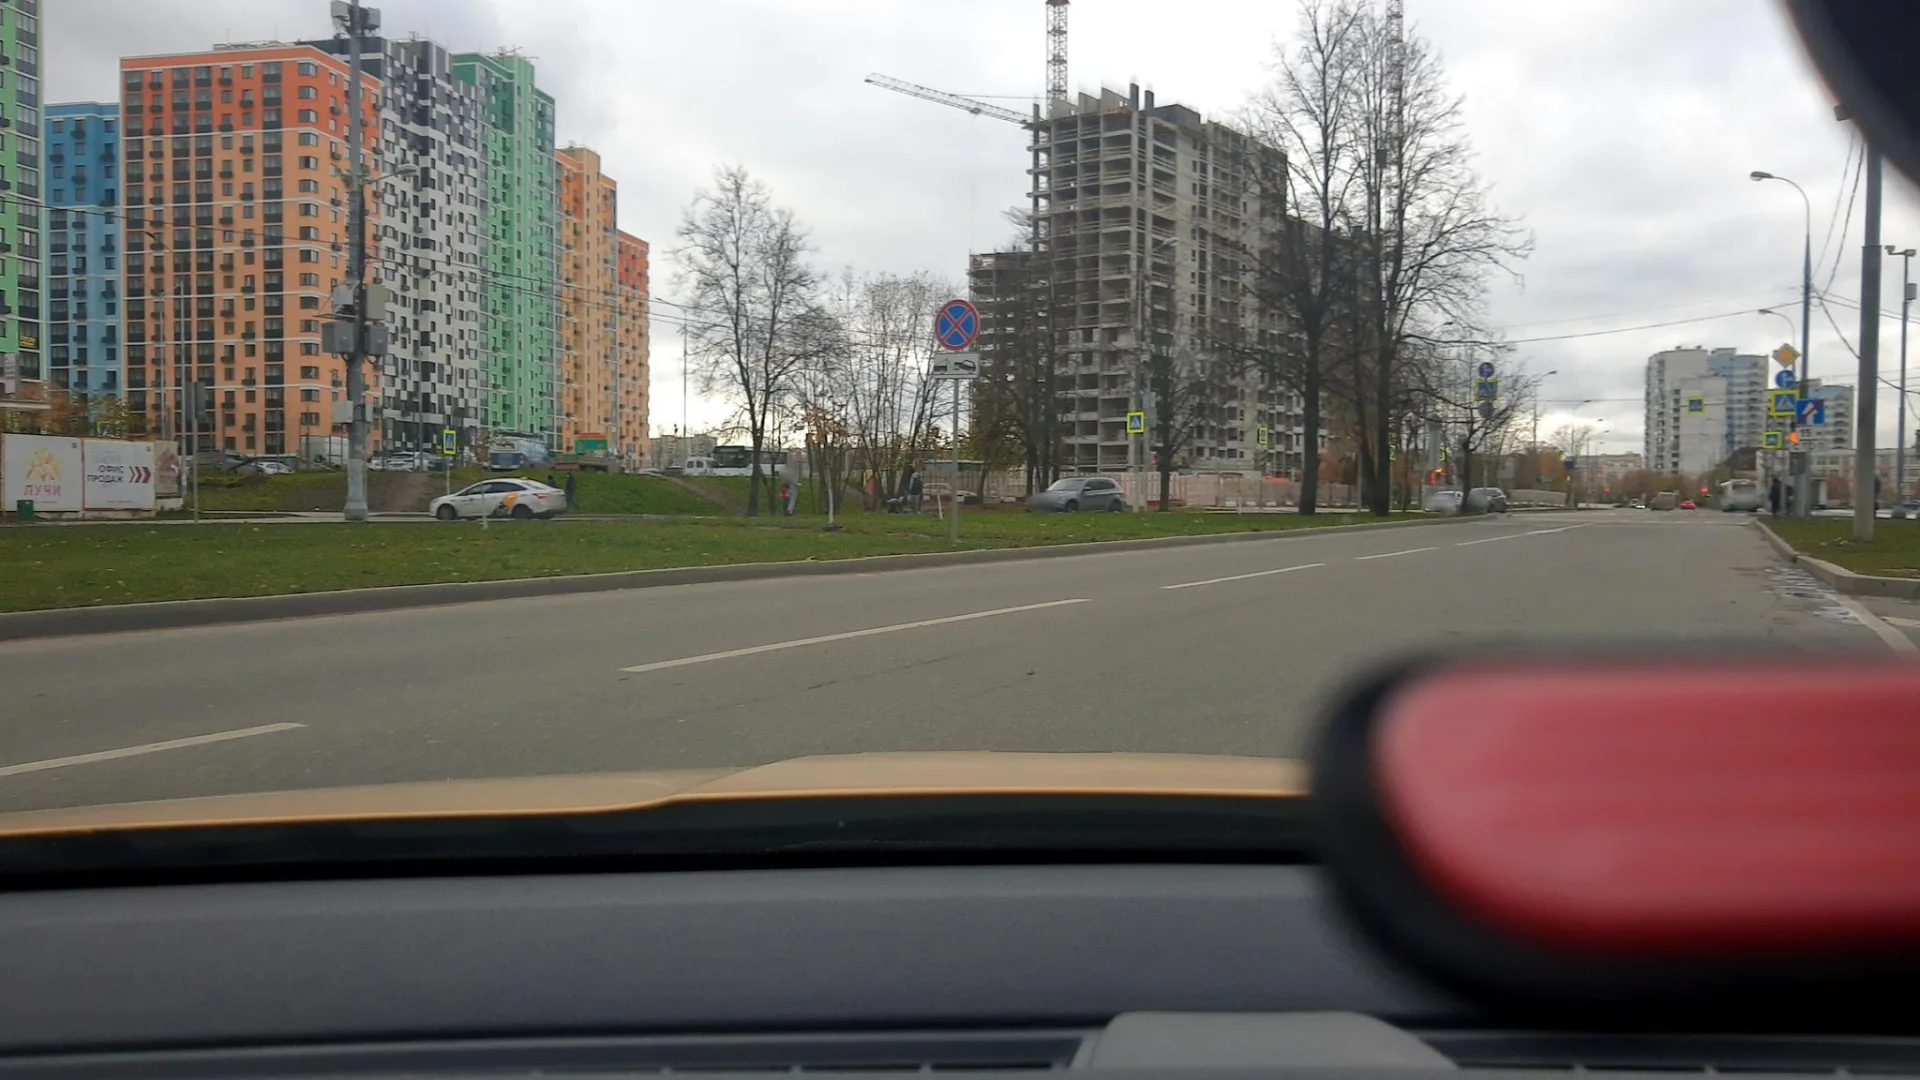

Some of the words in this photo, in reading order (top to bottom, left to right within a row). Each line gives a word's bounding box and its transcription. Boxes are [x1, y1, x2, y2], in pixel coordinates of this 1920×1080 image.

[98, 464, 124, 474] ОФИС
[87, 474, 124, 483] ПРОДАЖ
[24, 484, 61, 496] ЛУЧИ
